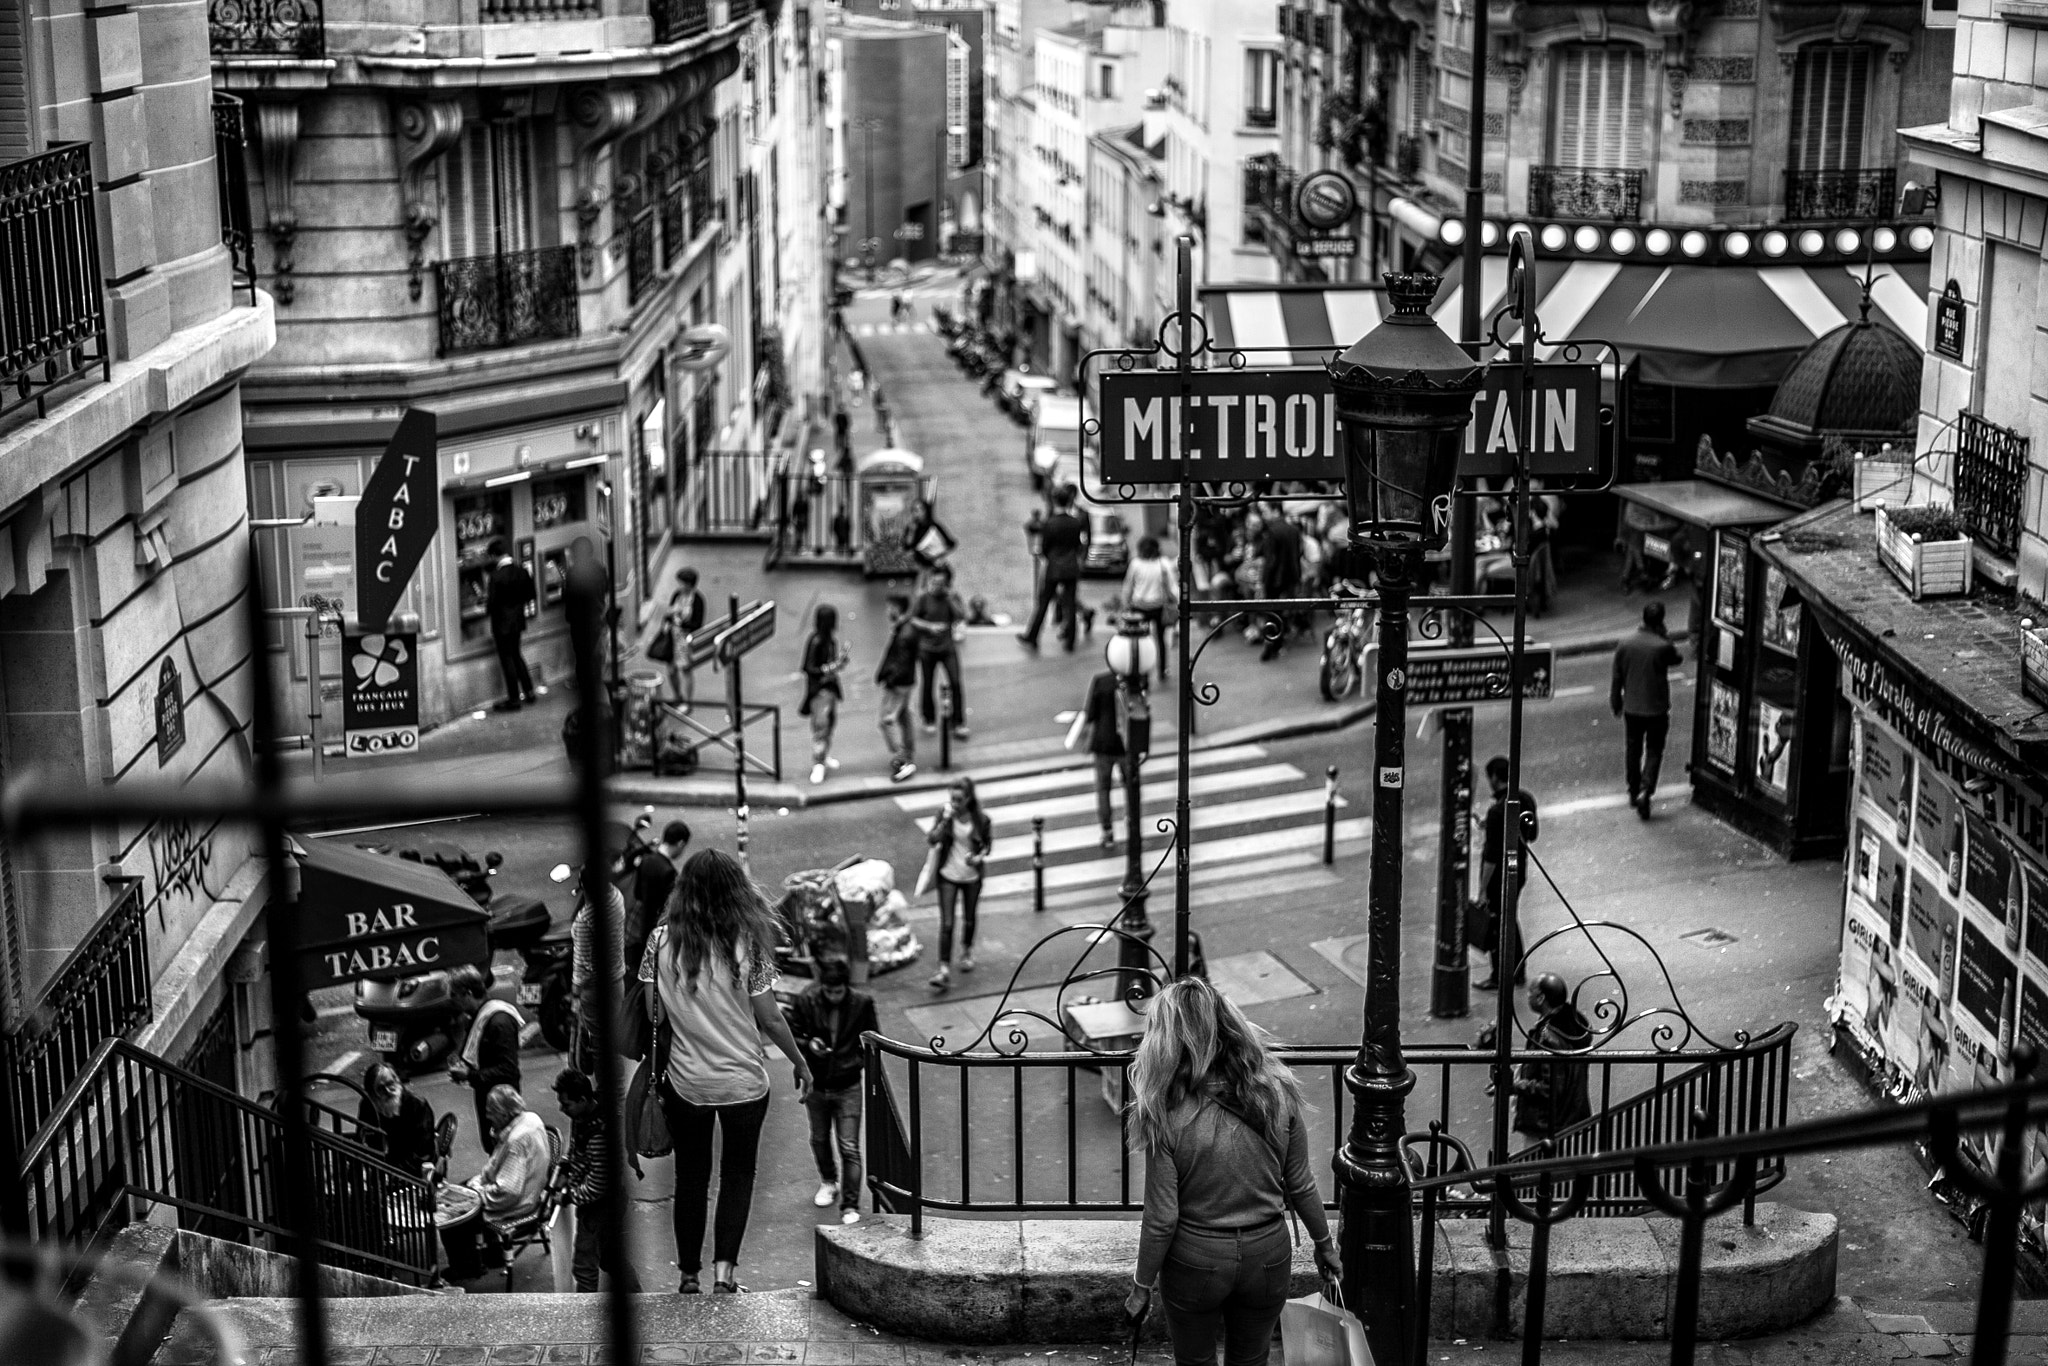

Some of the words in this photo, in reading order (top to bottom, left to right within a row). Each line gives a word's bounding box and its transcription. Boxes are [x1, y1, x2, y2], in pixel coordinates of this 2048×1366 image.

[376, 454, 421, 583] TABAC
[356, 702, 376, 713] DES
[379, 700, 406, 713] JEUX
[1870, 660, 1916, 724] Florales
[1917, 707, 1932, 736] et
[351, 730, 416, 754] LOTO
[345, 902, 418, 939] BAR
[1848, 917, 1874, 949] GIRLS
[324, 937, 441, 978] TABAC
[1902, 968, 1925, 1002] GIRLS
[1953, 1023, 1978, 1060] GIRLS
